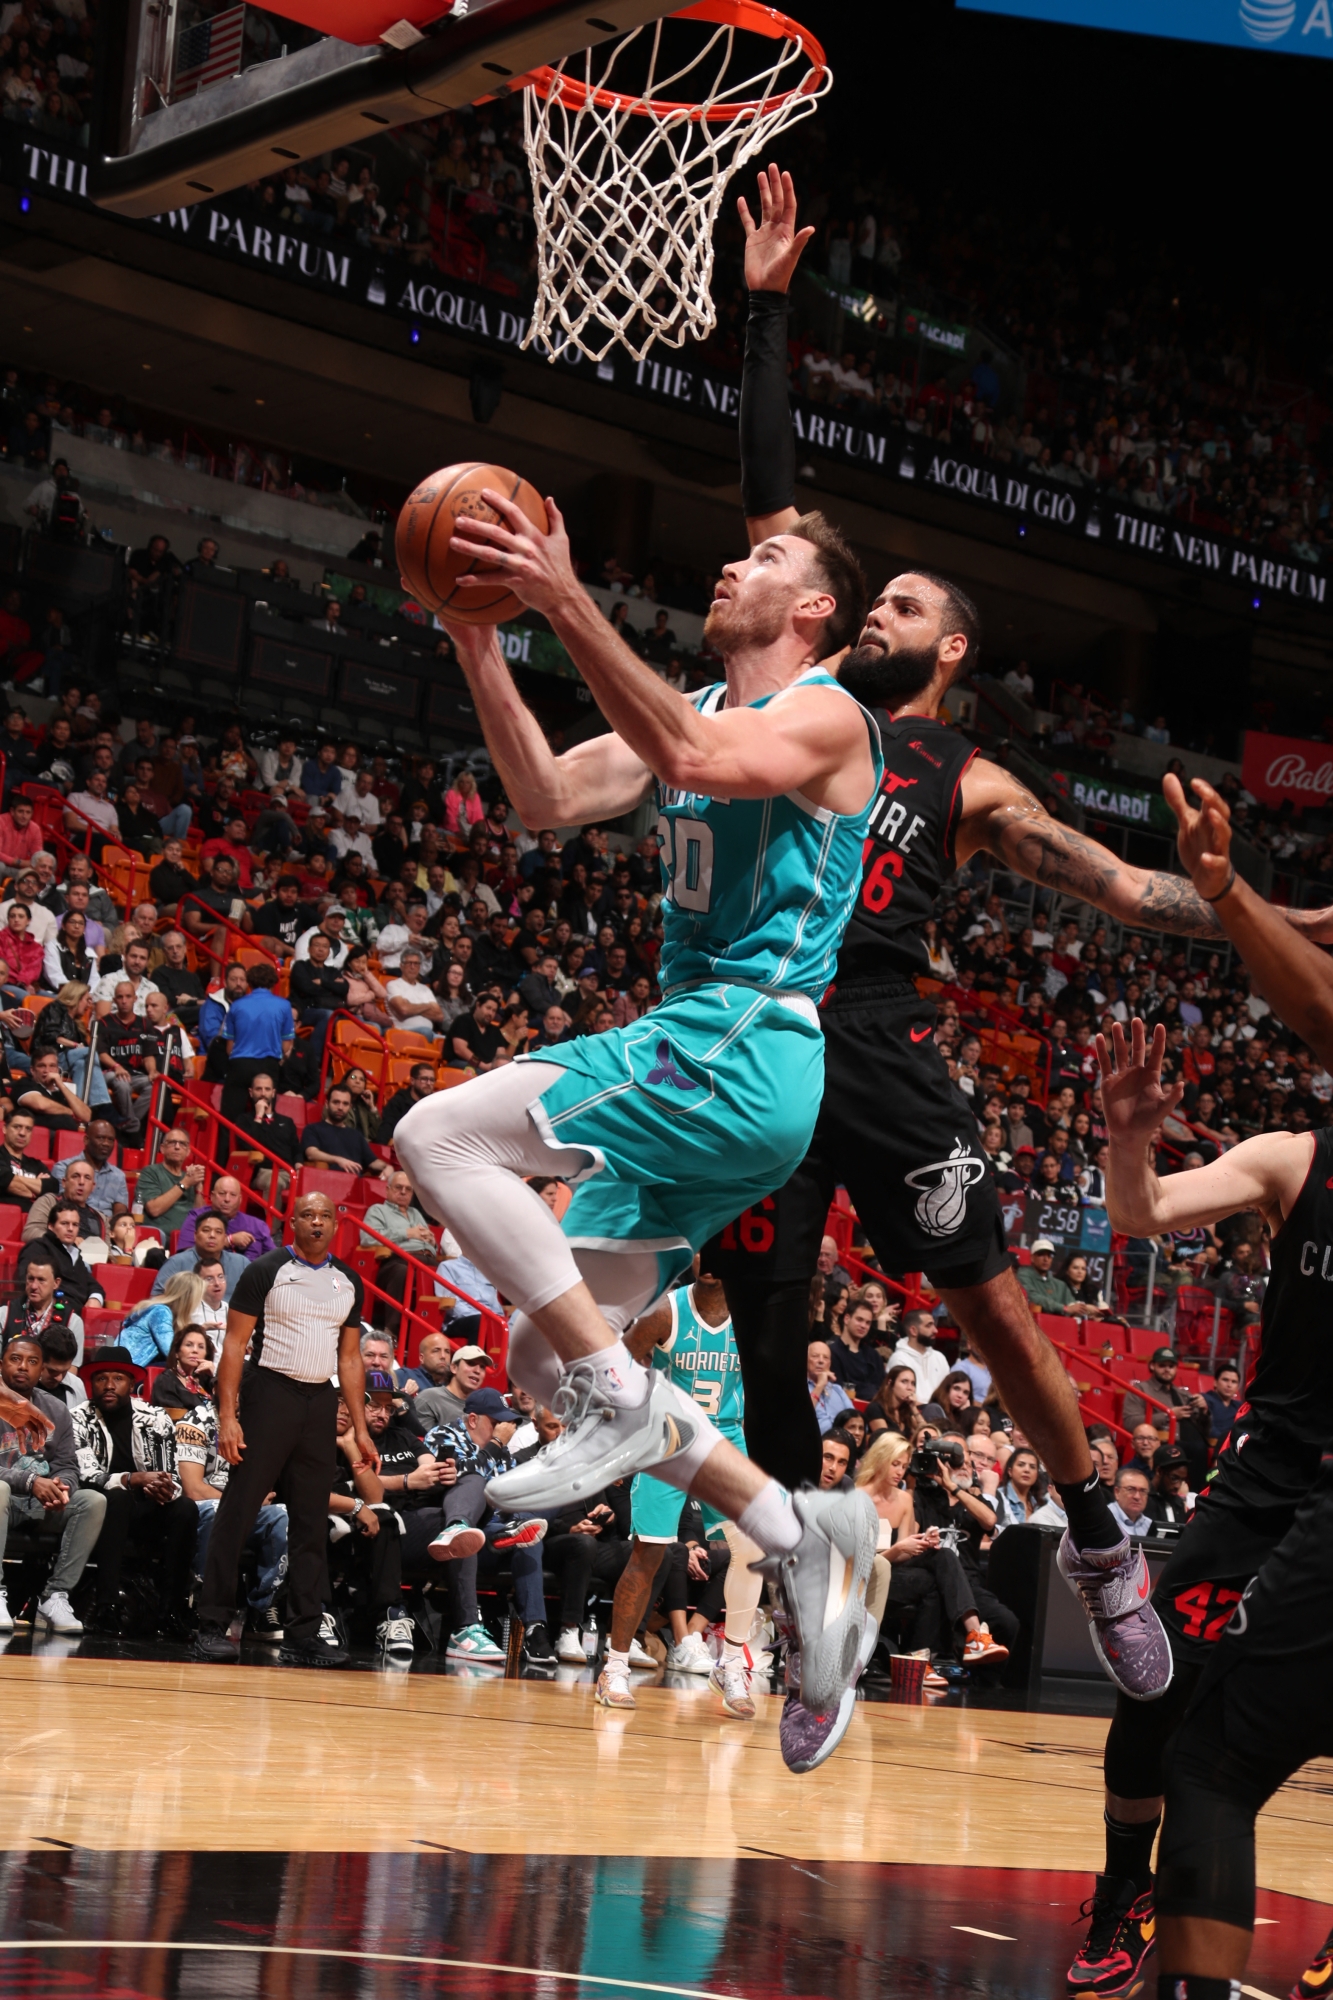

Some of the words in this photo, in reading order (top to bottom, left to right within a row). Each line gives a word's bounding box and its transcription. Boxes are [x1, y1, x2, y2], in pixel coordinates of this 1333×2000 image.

[23, 143, 87, 197] TH
[208, 209, 350, 287] PARFUM
[398, 279, 489, 336] ACQUA
[633, 359, 692, 402] THE
[700, 378, 739, 417] NE
[789, 407, 887, 465] ARFUM
[925, 455, 999, 502] ACQUA
[1004, 478, 1029, 511] DI
[1114, 512, 1166, 553] THE
[1170, 530, 1228, 571] NEW
[1231, 550, 1327, 603] PARFUM
[1073, 782, 1151, 822] BACARDÍ
[110, 1043, 144, 1057] CULTUR
[1038, 1203, 1080, 1233] 2:58
[675, 1351, 741, 1373] HORNETS
[691, 1379, 722, 1416] 3
